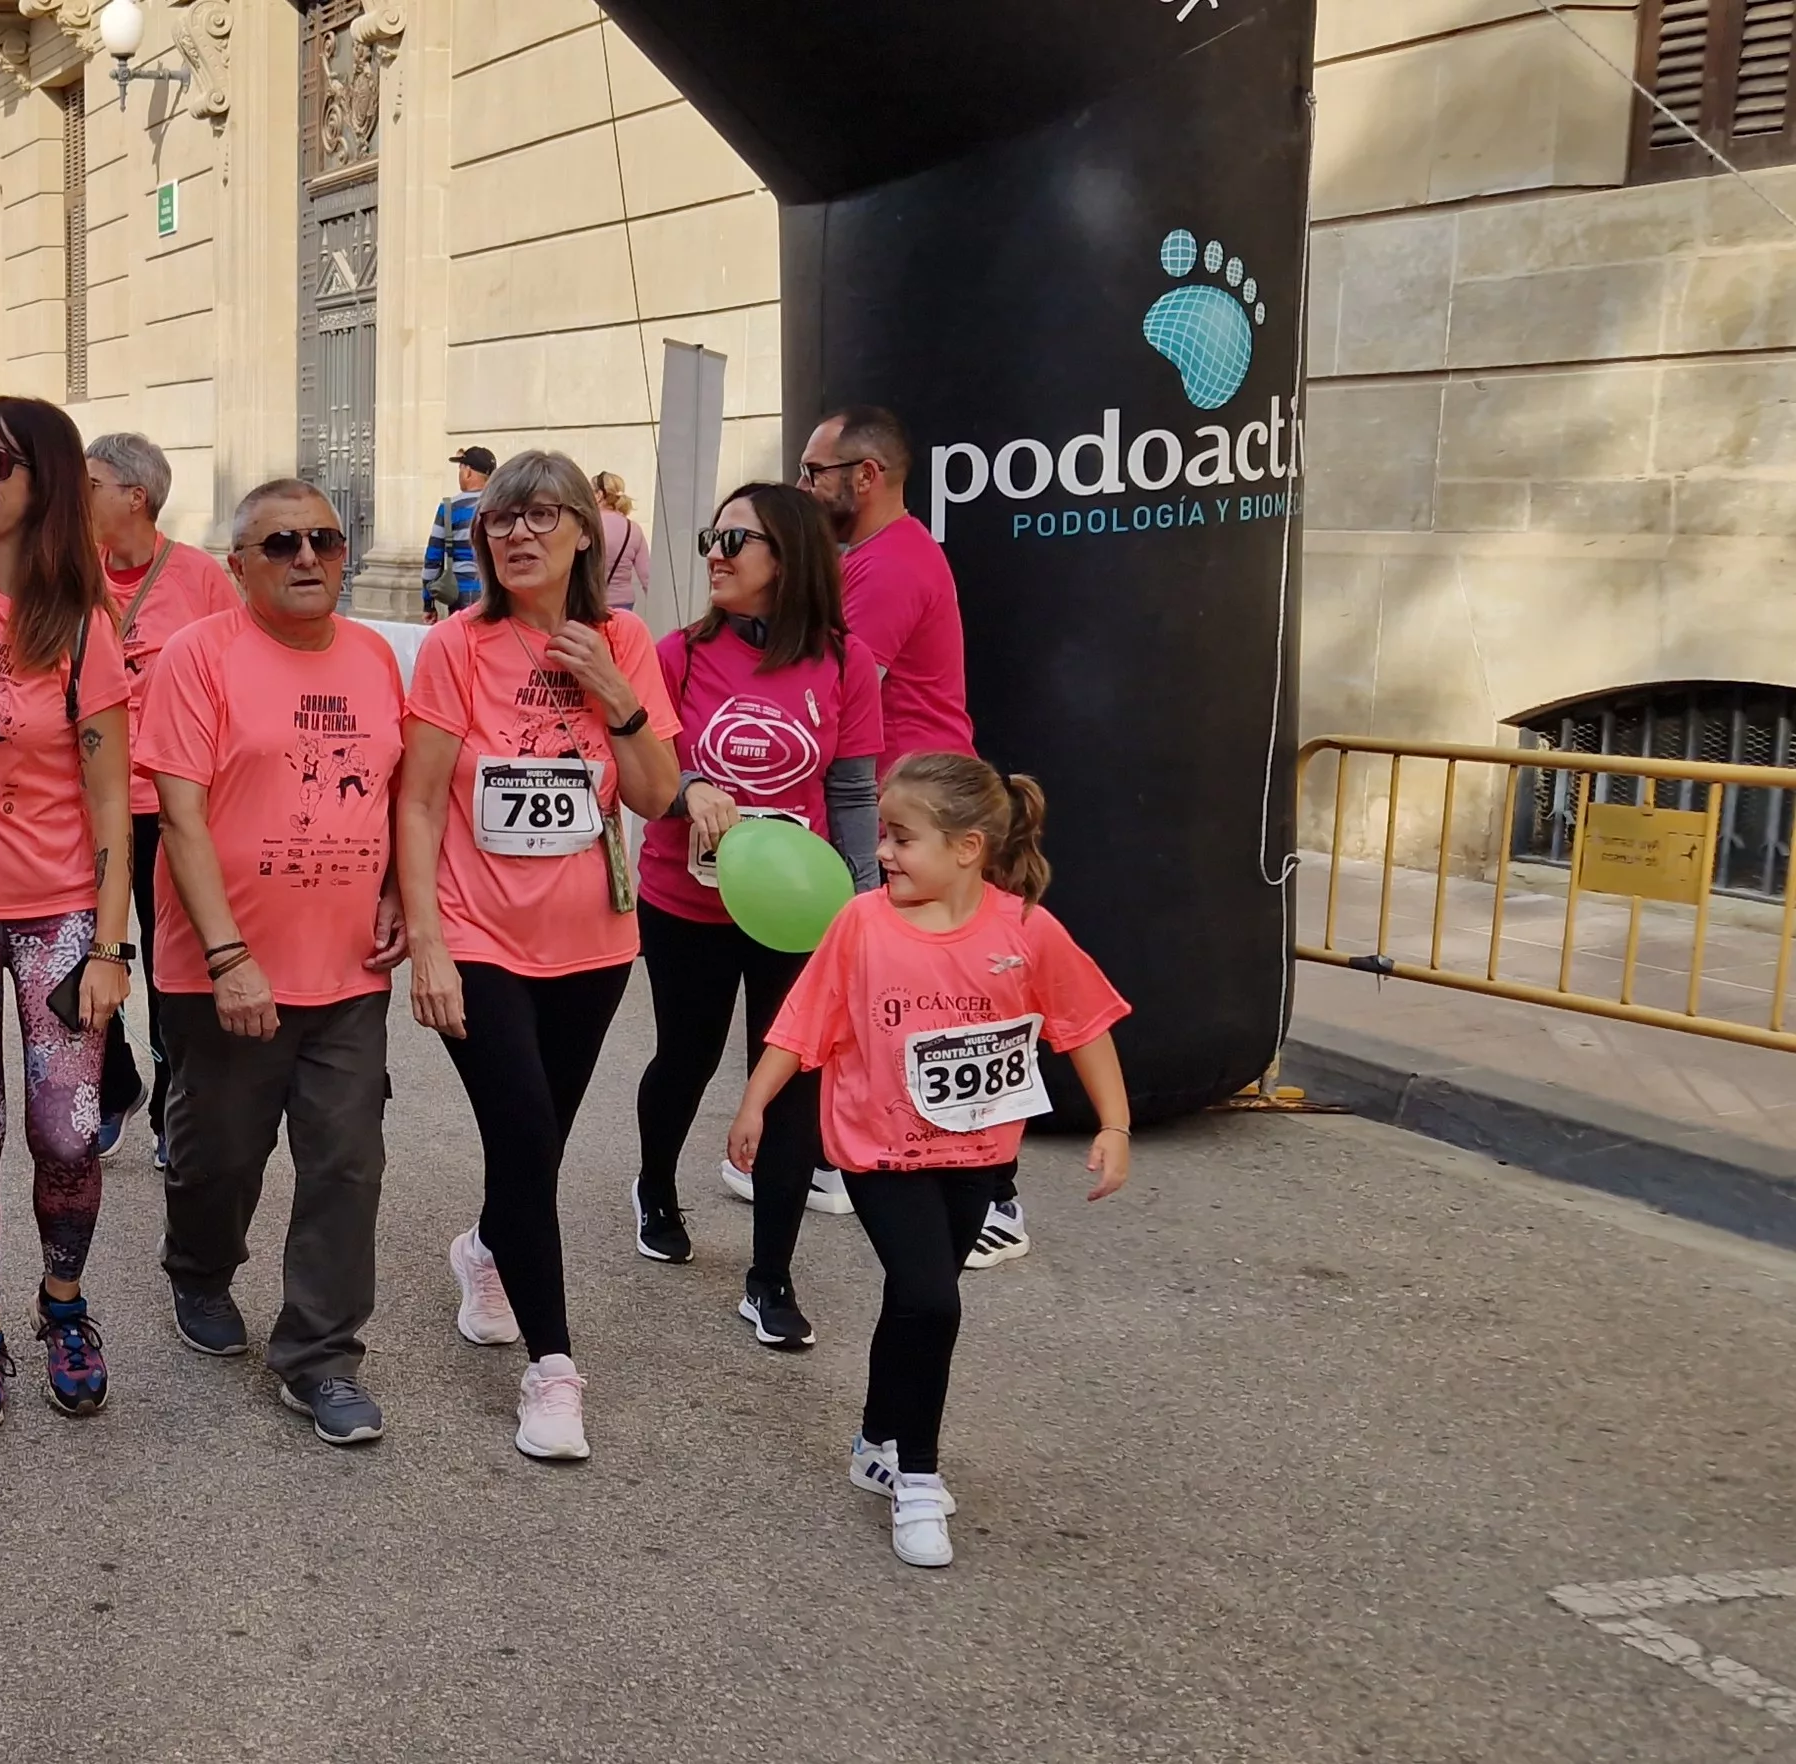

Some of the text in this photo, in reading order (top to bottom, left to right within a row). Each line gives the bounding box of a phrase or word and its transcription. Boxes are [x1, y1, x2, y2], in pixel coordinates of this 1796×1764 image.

[1013, 495, 1205, 538] PODOLOGÍA
[1216, 499, 1231, 523] Y
[300, 694, 348, 714] CORRAMOS
[514, 687, 537, 706] POR
[294, 711, 357, 732] POR LA CIENCIA
[730, 746, 768, 758] JUNTOS
[490, 775, 585, 787] CONTRA EL CÁNCER
[526, 770, 553, 778] HUESCA
[501, 793, 575, 828] 789
[884, 991, 992, 1027] 9ª CÁNCER
[924, 1033, 1027, 1062] CONTRA EL CÁNCER
[964, 1034, 998, 1046] HUESCA
[924, 1049, 1026, 1105] 3988
